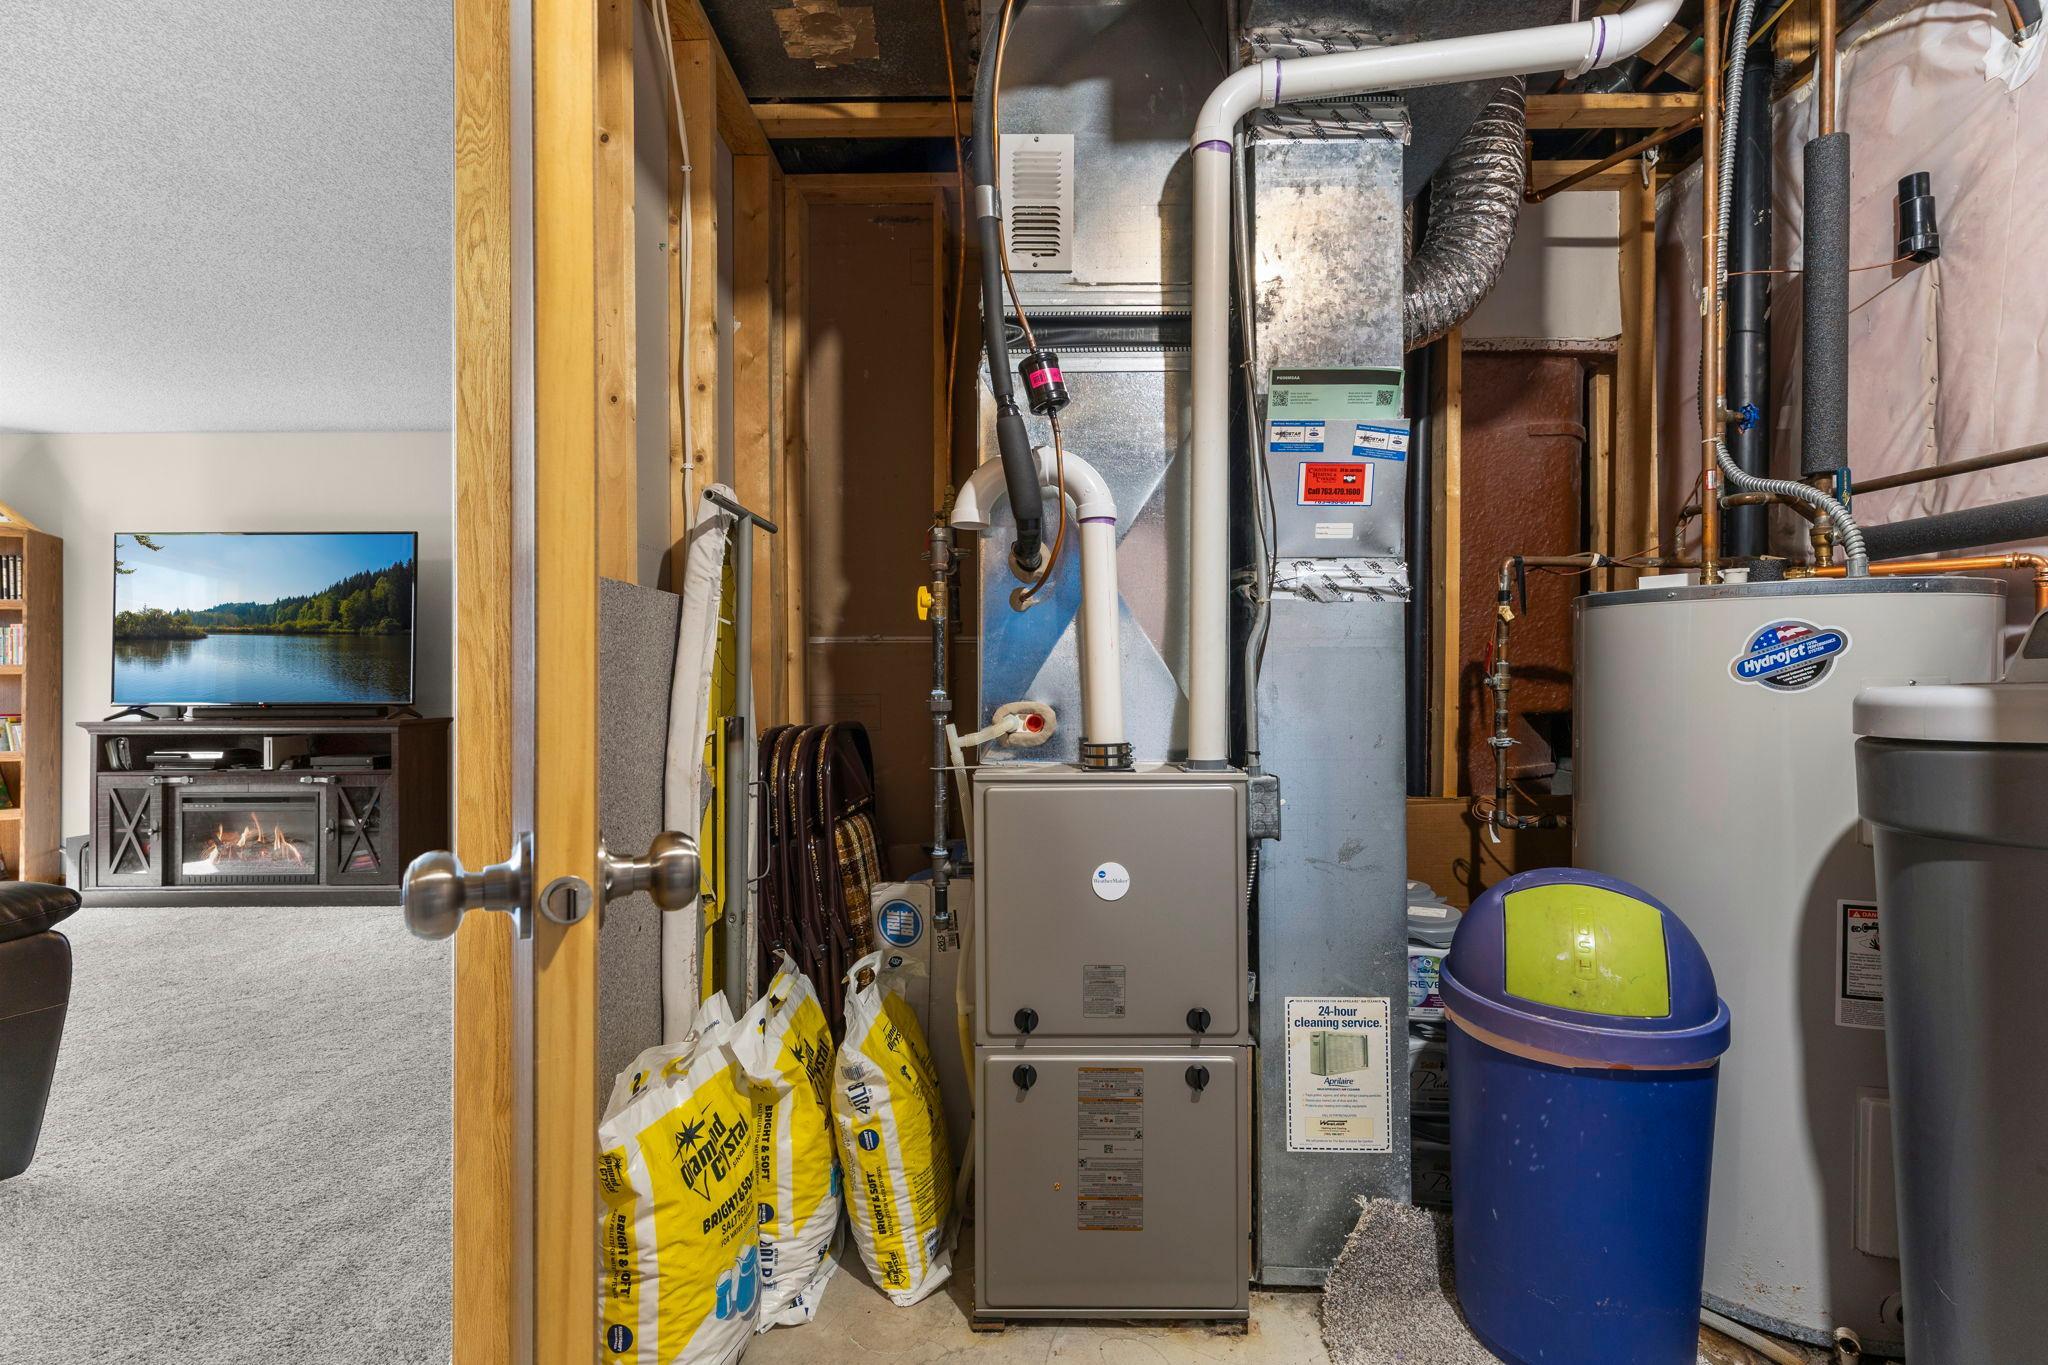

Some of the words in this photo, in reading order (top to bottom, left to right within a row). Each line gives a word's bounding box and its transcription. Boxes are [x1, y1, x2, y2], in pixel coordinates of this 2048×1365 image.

[1096, 328, 1144, 341] EXCELON
[1307, 487, 1320, 495] Call
[1743, 643, 1806, 674] Hydrojet
[886, 910, 900, 936] TRUE
[900, 910, 914, 937] BLUE
[1408, 980, 1440, 989] REVE
[1318, 1005, 1357, 1017] 24-hour
[1294, 1017, 1339, 1030] cleaning
[1342, 1017, 1382, 1028] service.
[1323, 1077, 1354, 1087] Aprilaire
[847, 1082, 871, 1115] 40LB
[761, 1104, 773, 1143] BRIGHT
[711, 1112, 749, 1182] Crystal
[761, 1145, 769, 1153] &
[761, 1155, 770, 1181] SOFT
[866, 1171, 879, 1194] SOFT
[869, 1194, 880, 1202] &
[702, 1194, 739, 1235] BRIGHT
[721, 1215, 737, 1236] SALT
[873, 1204, 887, 1235] BRIGHT
[617, 1215, 630, 1256] BRIGHT
[618, 1259, 629, 1268] &
